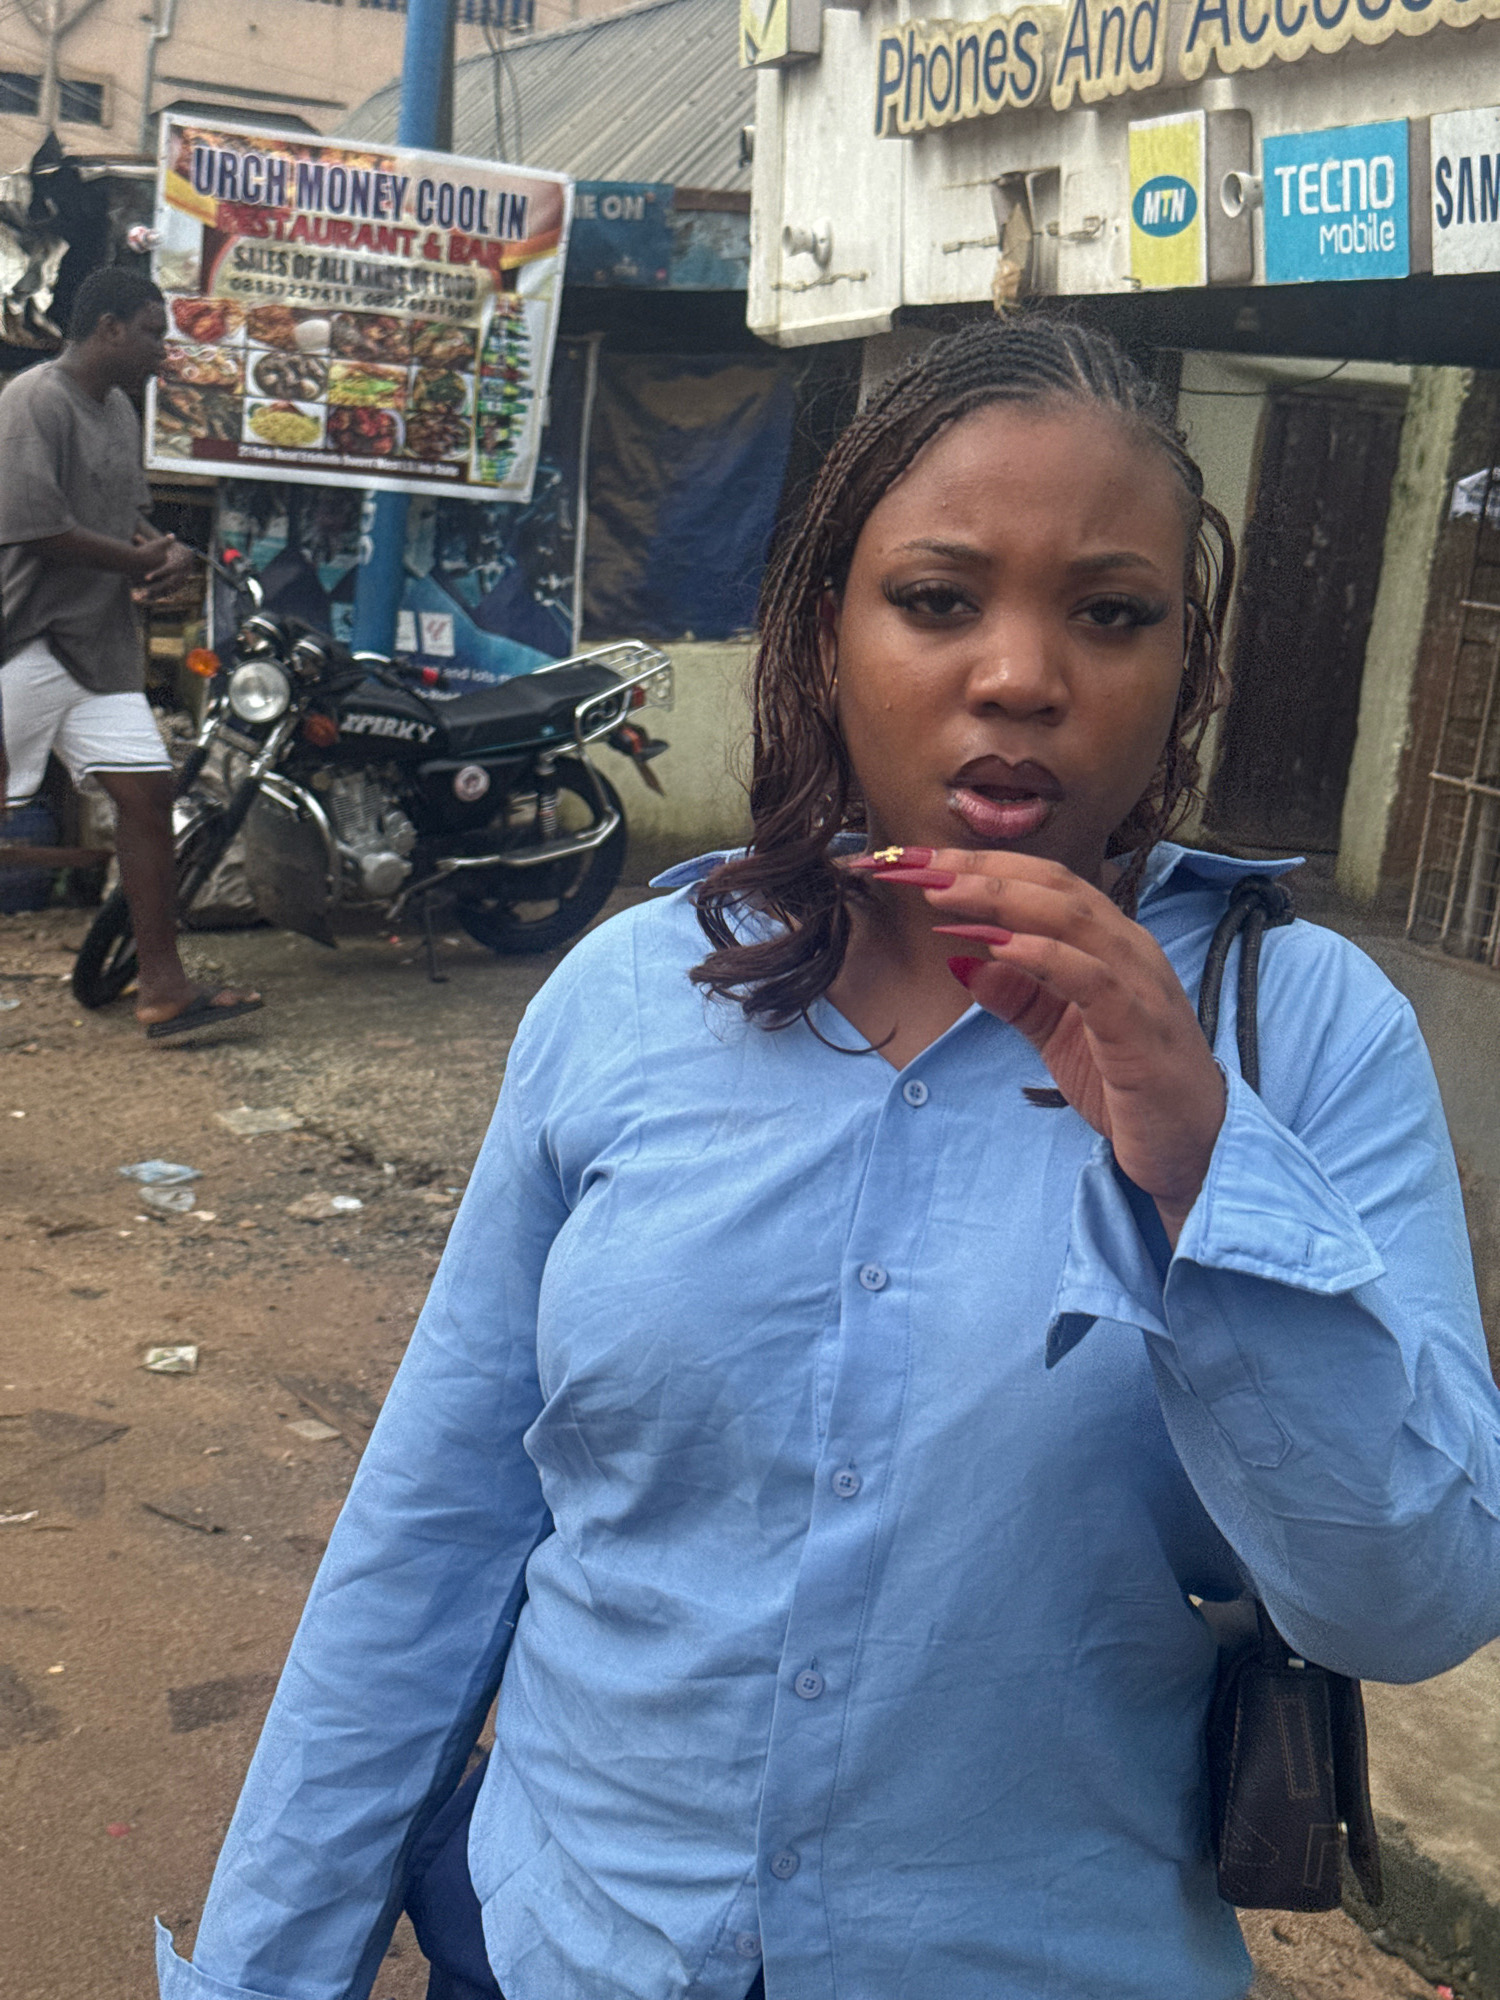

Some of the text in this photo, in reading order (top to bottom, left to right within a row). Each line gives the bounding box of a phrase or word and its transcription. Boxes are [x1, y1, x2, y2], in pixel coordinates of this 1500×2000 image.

[875, 20, 1038, 137] Phones
[1057, 0, 1161, 86] And
[194, 147, 528, 240] URCH MONEY COOL IN
[1142, 187, 1187, 226] MTN
[1274, 155, 1396, 217] TECNO
[217, 203, 504, 271] RESTAURANT & BAR
